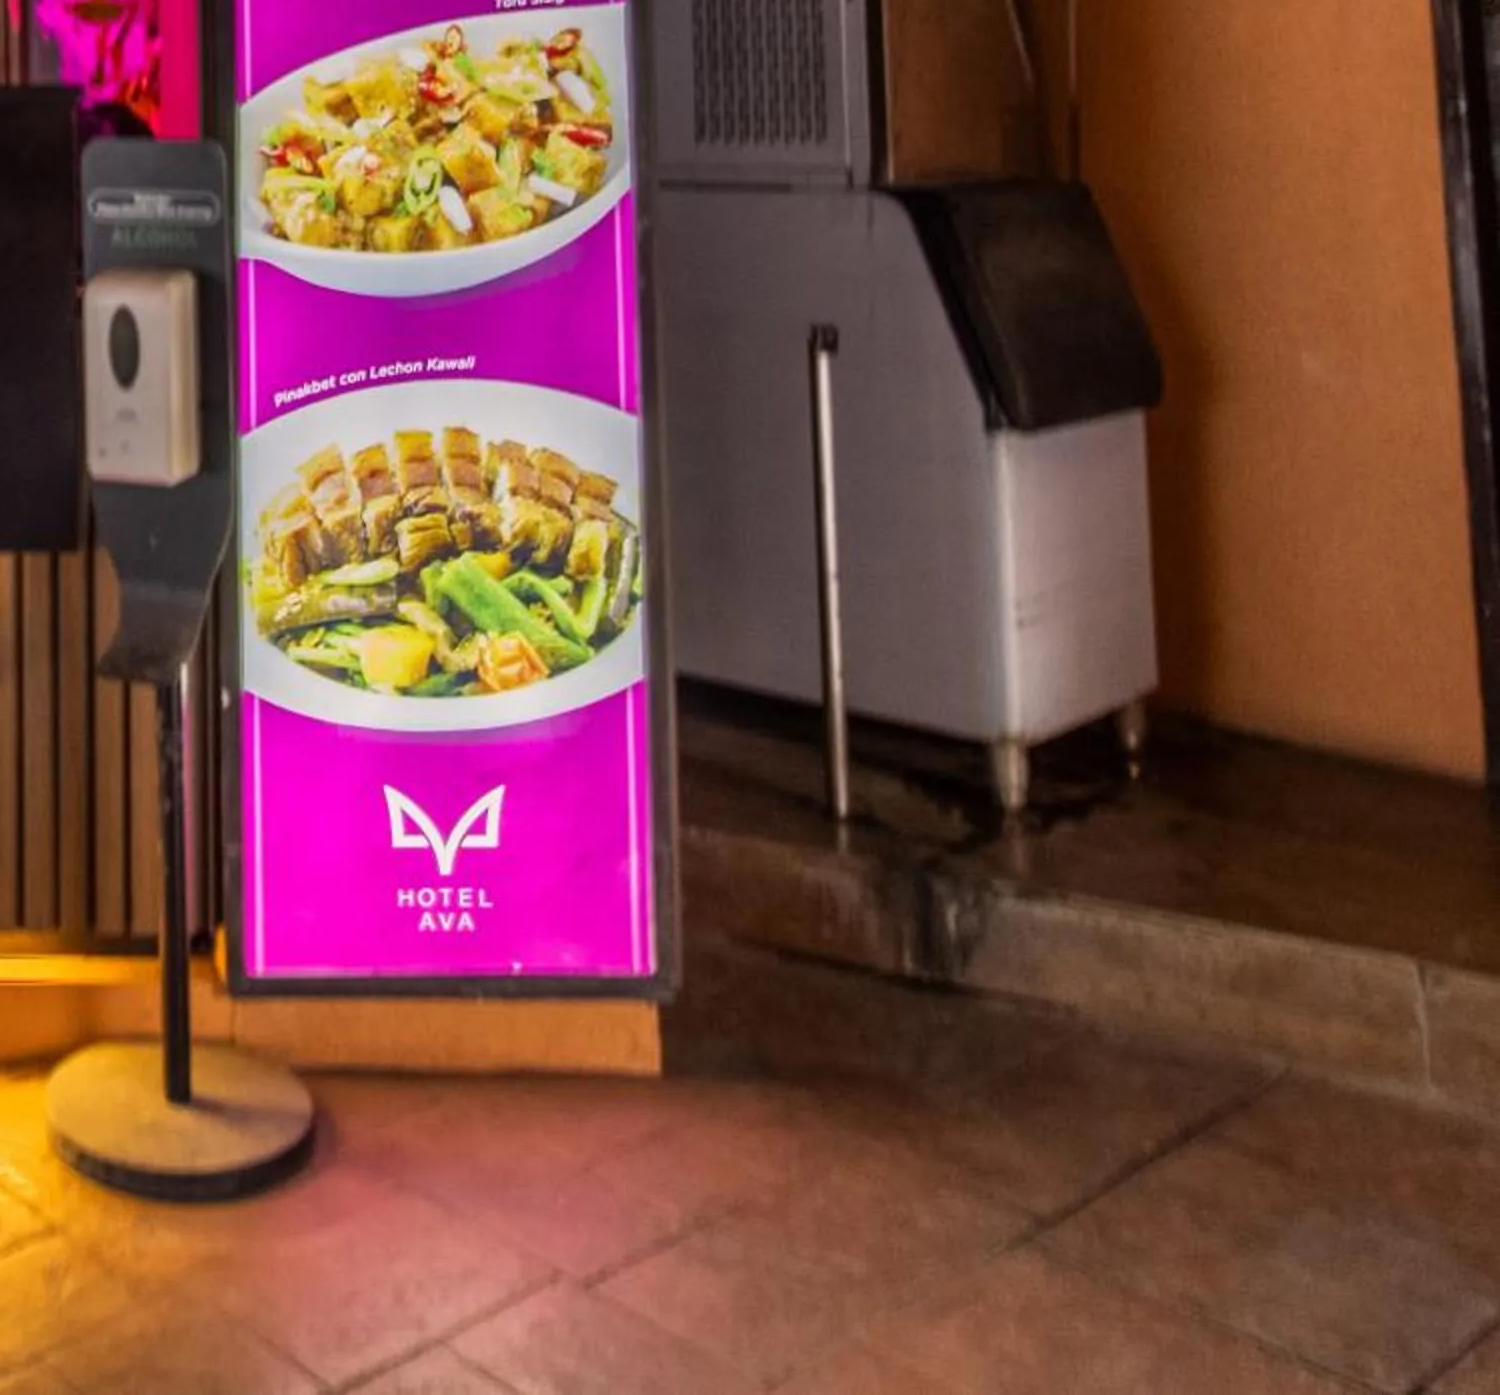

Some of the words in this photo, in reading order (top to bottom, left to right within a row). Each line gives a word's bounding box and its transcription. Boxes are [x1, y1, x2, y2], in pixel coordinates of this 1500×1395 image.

[273, 375, 336, 408] Pinakbet
[339, 370, 367, 385] con
[370, 360, 423, 380] Lechon
[426, 355, 476, 371] Kawali
[397, 887, 494, 908] HOTEL
[418, 911, 475, 932] AVA
